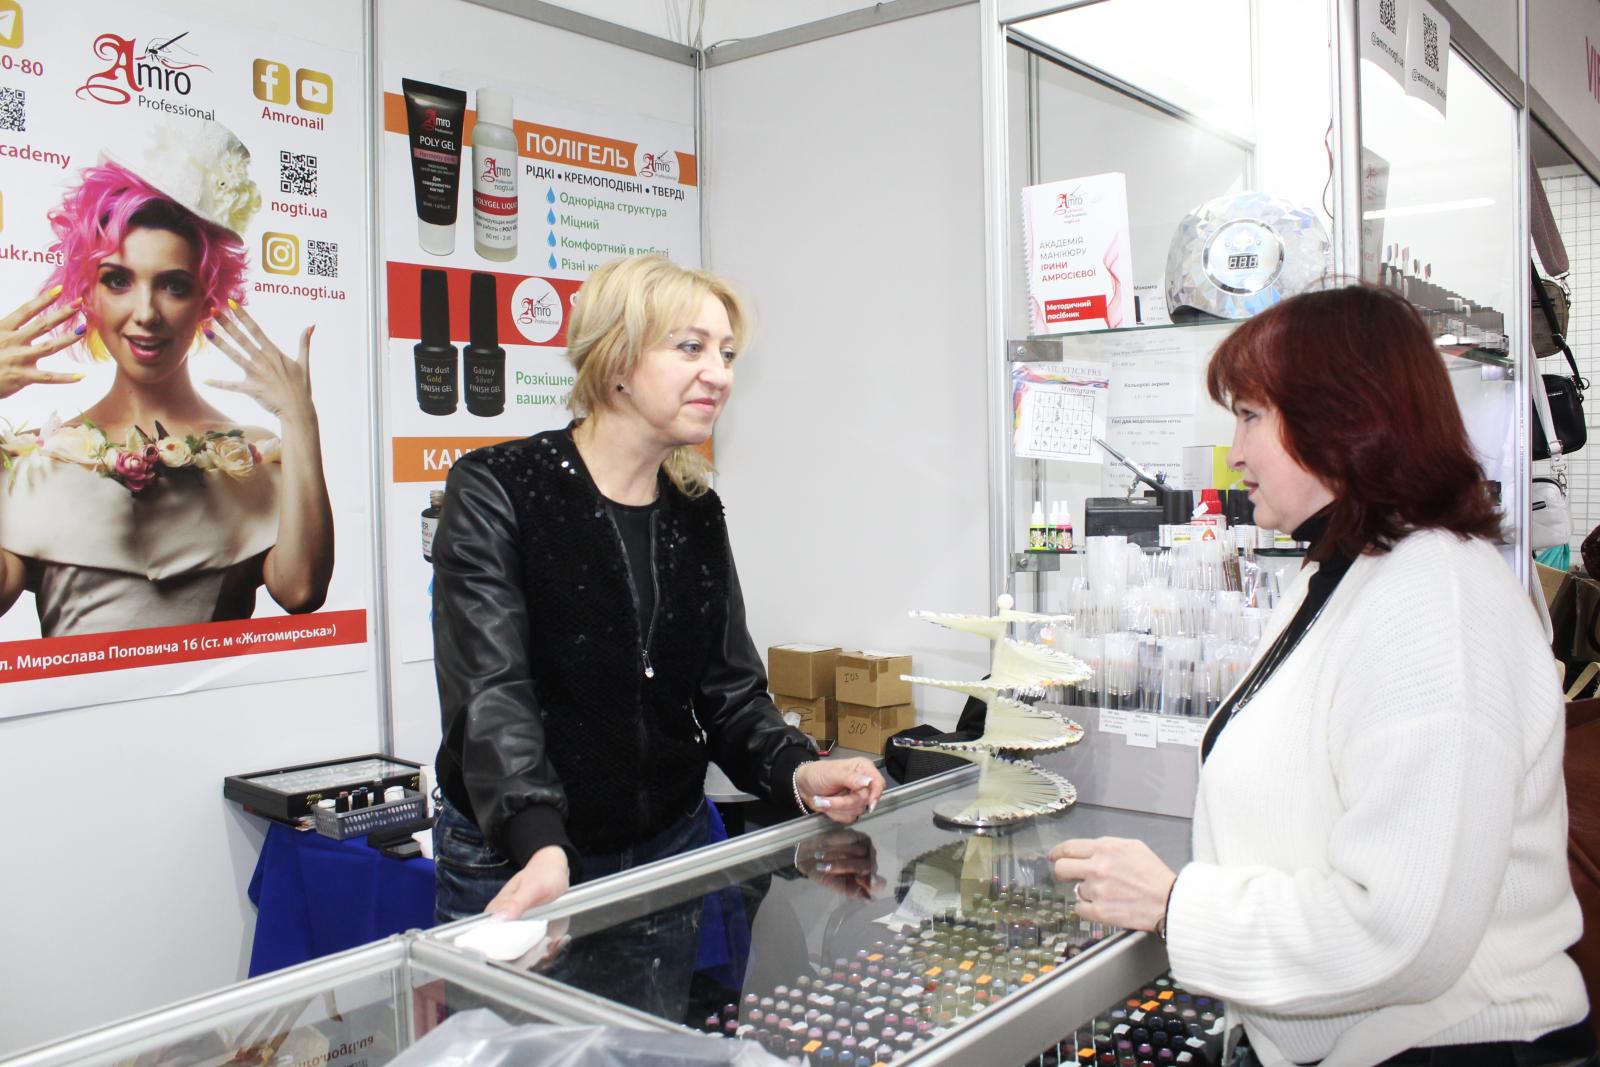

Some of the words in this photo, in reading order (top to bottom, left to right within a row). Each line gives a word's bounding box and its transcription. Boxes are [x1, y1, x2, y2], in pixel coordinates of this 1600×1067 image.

[75, 33, 192, 105] Amro
[138, 94, 215, 121] Professional
[262, 107, 324, 131] Amronail
[420, 135, 440, 147] POLY
[441, 140, 456, 151] GEL
[526, 132, 629, 168] ПОЛІГЕЛЬ
[526, 165, 554, 179] РІДКІ
[564, 171, 643, 194] КРЕМОПОДІБНІ
[652, 185, 685, 201] ТВЕРДІ
[271, 201, 328, 218] nogti.ua
[560, 192, 615, 211] Однорідна
[617, 203, 667, 218] структура
[560, 214, 600, 230] Міцний
[561, 236, 627, 255] Комфортний
[1040, 236, 1084, 249] АКАДЕМІЯ
[1040, 248, 1087, 260] МАНІКЮРУ
[561, 257, 586, 271] Різні
[1041, 261, 1068, 271] ІРИНИ
[1042, 267, 1096, 282] АМРОСІЄВОЇ
[254, 282, 346, 300] amro.nogti.ua
[517, 297, 551, 324] Amro
[1047, 299, 1092, 310] Методичний
[1047, 311, 1080, 320] посібник
[420, 364, 433, 374] Star
[434, 366, 450, 374] dust
[473, 366, 495, 376] Galaxy
[426, 375, 442, 383] Gold
[516, 370, 574, 386] Розкішне
[420, 383, 440, 393] FINISH
[441, 385, 453, 393] GEL
[470, 383, 490, 393] FINISH
[516, 393, 556, 405] ваших
[17, 650, 105, 669] Мирослава
[109, 643, 178, 659] Поповича
[183, 638, 198, 651] 16
[201, 636, 222, 650] (ст.
[223, 637, 232, 646] м
[236, 623, 336, 645] «Житомирська»)
